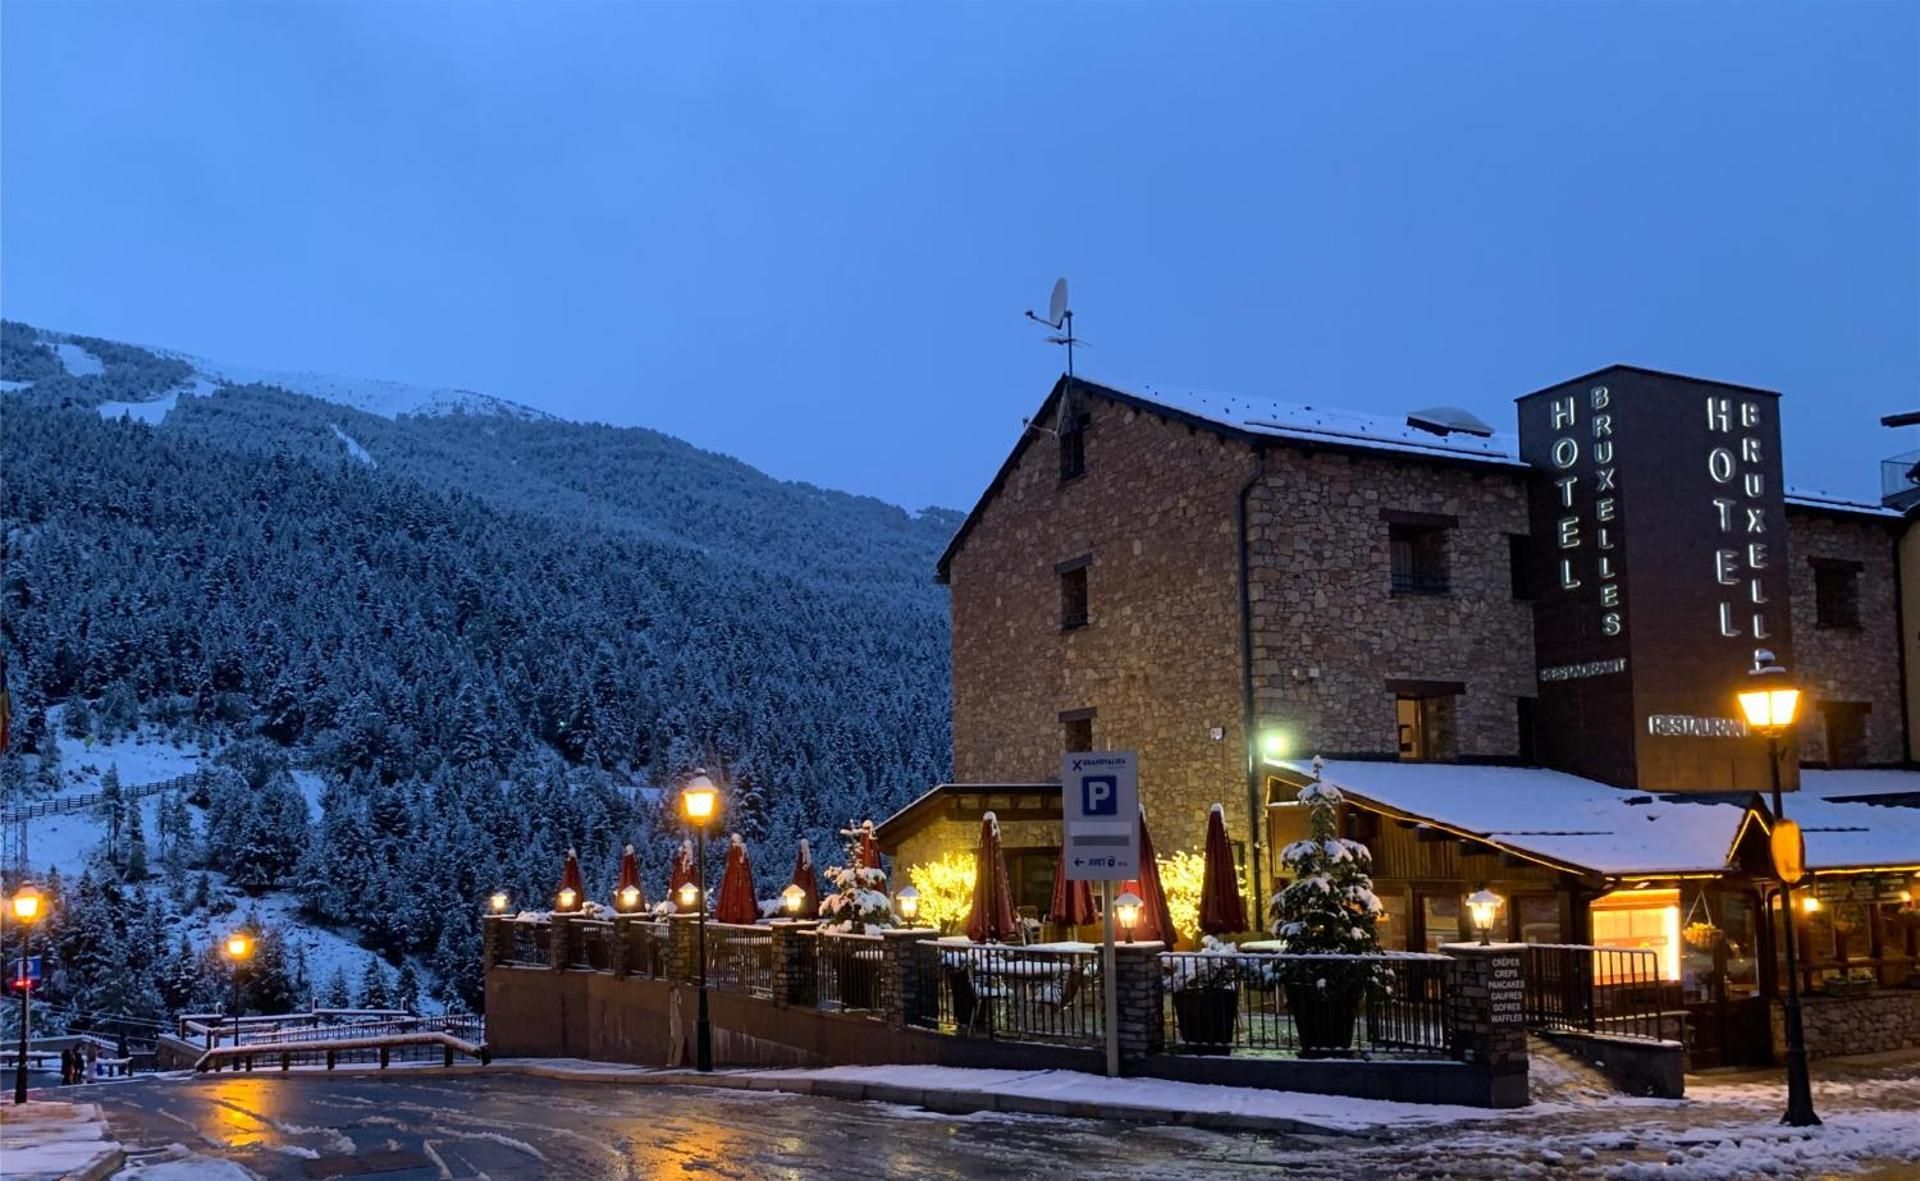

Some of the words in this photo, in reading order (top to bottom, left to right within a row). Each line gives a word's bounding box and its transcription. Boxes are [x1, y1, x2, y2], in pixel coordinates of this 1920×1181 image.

[1551, 396, 1581, 590] HOTEL
[1590, 386, 1621, 636] BRUXELLES
[1708, 396, 1741, 637] HOTEL
[1088, 782, 1110, 811] P
